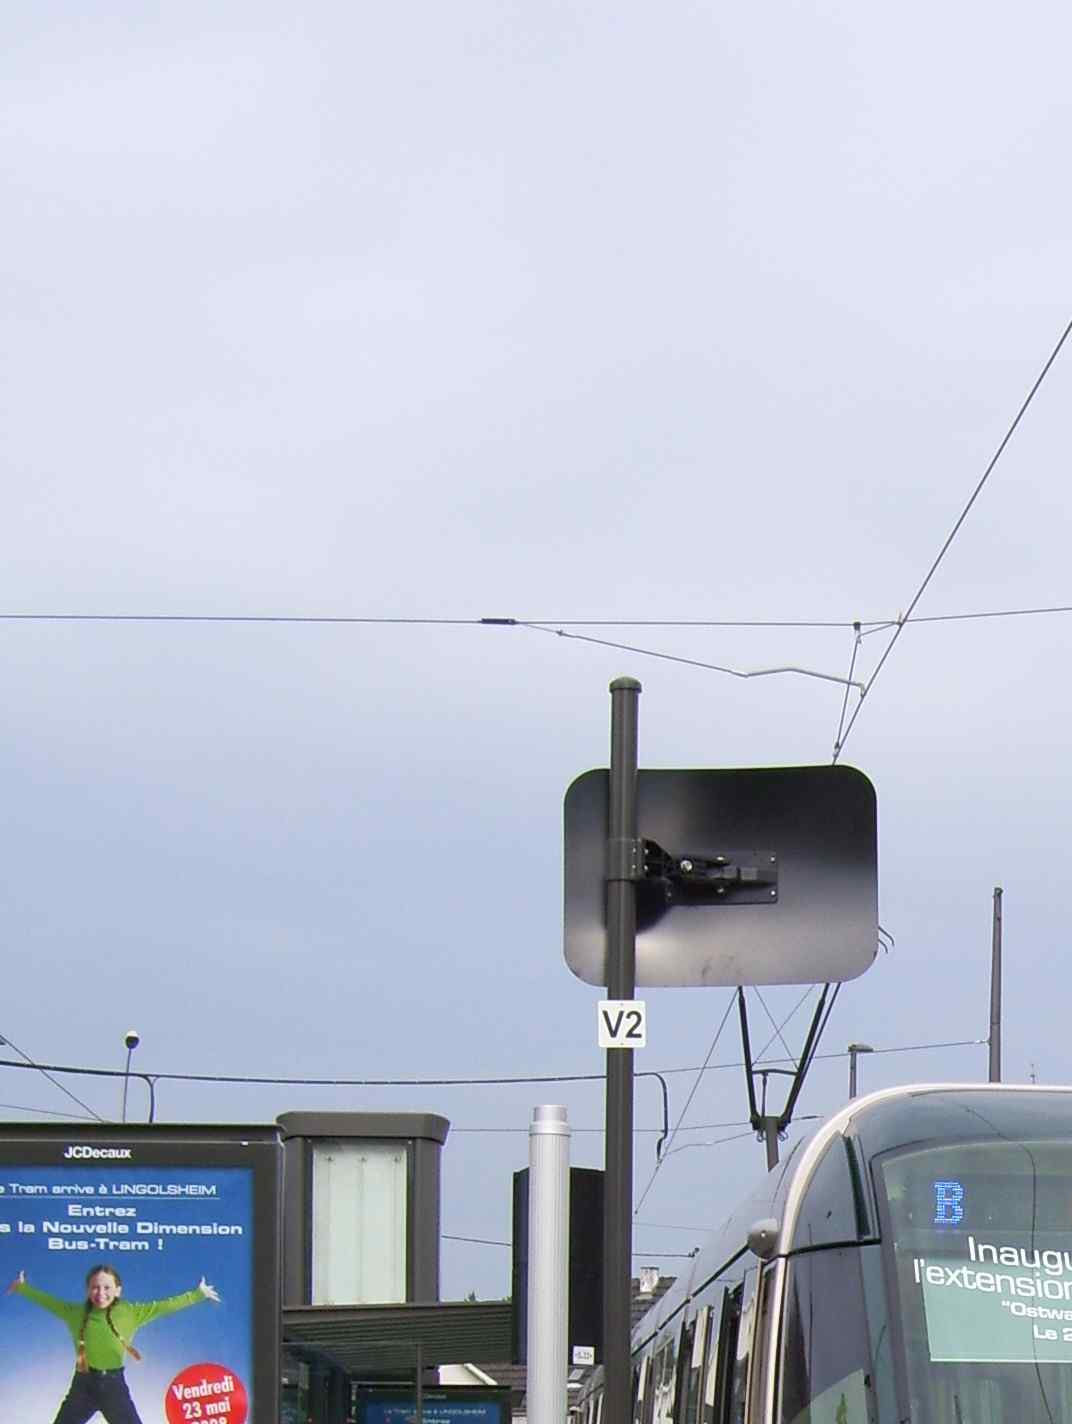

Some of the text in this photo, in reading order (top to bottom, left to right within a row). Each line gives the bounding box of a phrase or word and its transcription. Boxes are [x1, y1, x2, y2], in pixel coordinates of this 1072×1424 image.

[602, 1010, 642, 1039] V2
[64, 1146, 132, 1159] JCDecaux
[9, 1183, 48, 1194] Tram
[52, 1183, 95, 1195] arrive
[99, 1183, 108, 1194] à
[112, 1184, 217, 1195] LINGOLSHEIM
[934, 1181, 964, 1224] B
[68, 1204, 137, 1217] Entrez
[18, 1221, 35, 1233] la
[43, 1221, 129, 1234] Nouvelle
[137, 1222, 243, 1235] Dimension
[48, 1237, 164, 1250] Bus-Tram !
[1033, 1325, 1058, 1341] Le
[172, 1375, 235, 1401] Vendredi
[182, 1396, 232, 1419] 23 mai
